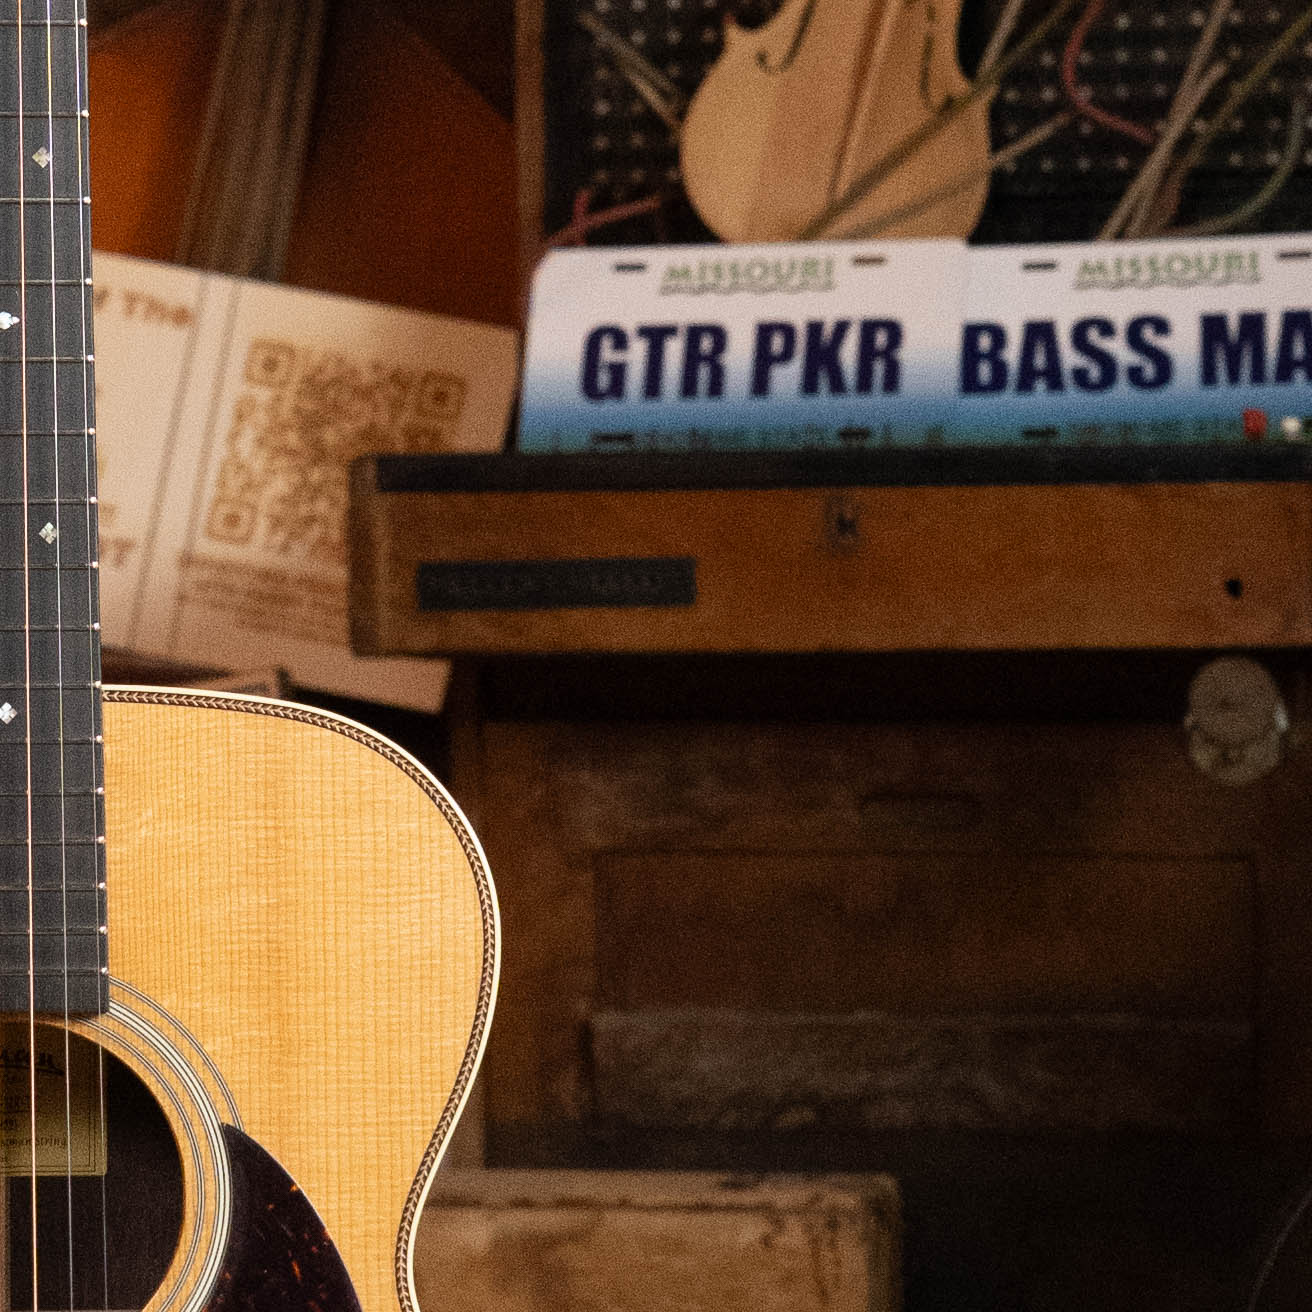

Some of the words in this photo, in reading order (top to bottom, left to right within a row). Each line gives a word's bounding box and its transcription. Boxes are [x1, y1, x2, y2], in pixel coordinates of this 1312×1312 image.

[662, 257, 836, 288] MISSOURI
[1075, 250, 1261, 286] MISSOURI
[579, 322, 729, 401] GTR
[750, 318, 904, 398] PKR
[957, 314, 1173, 395] BASS
